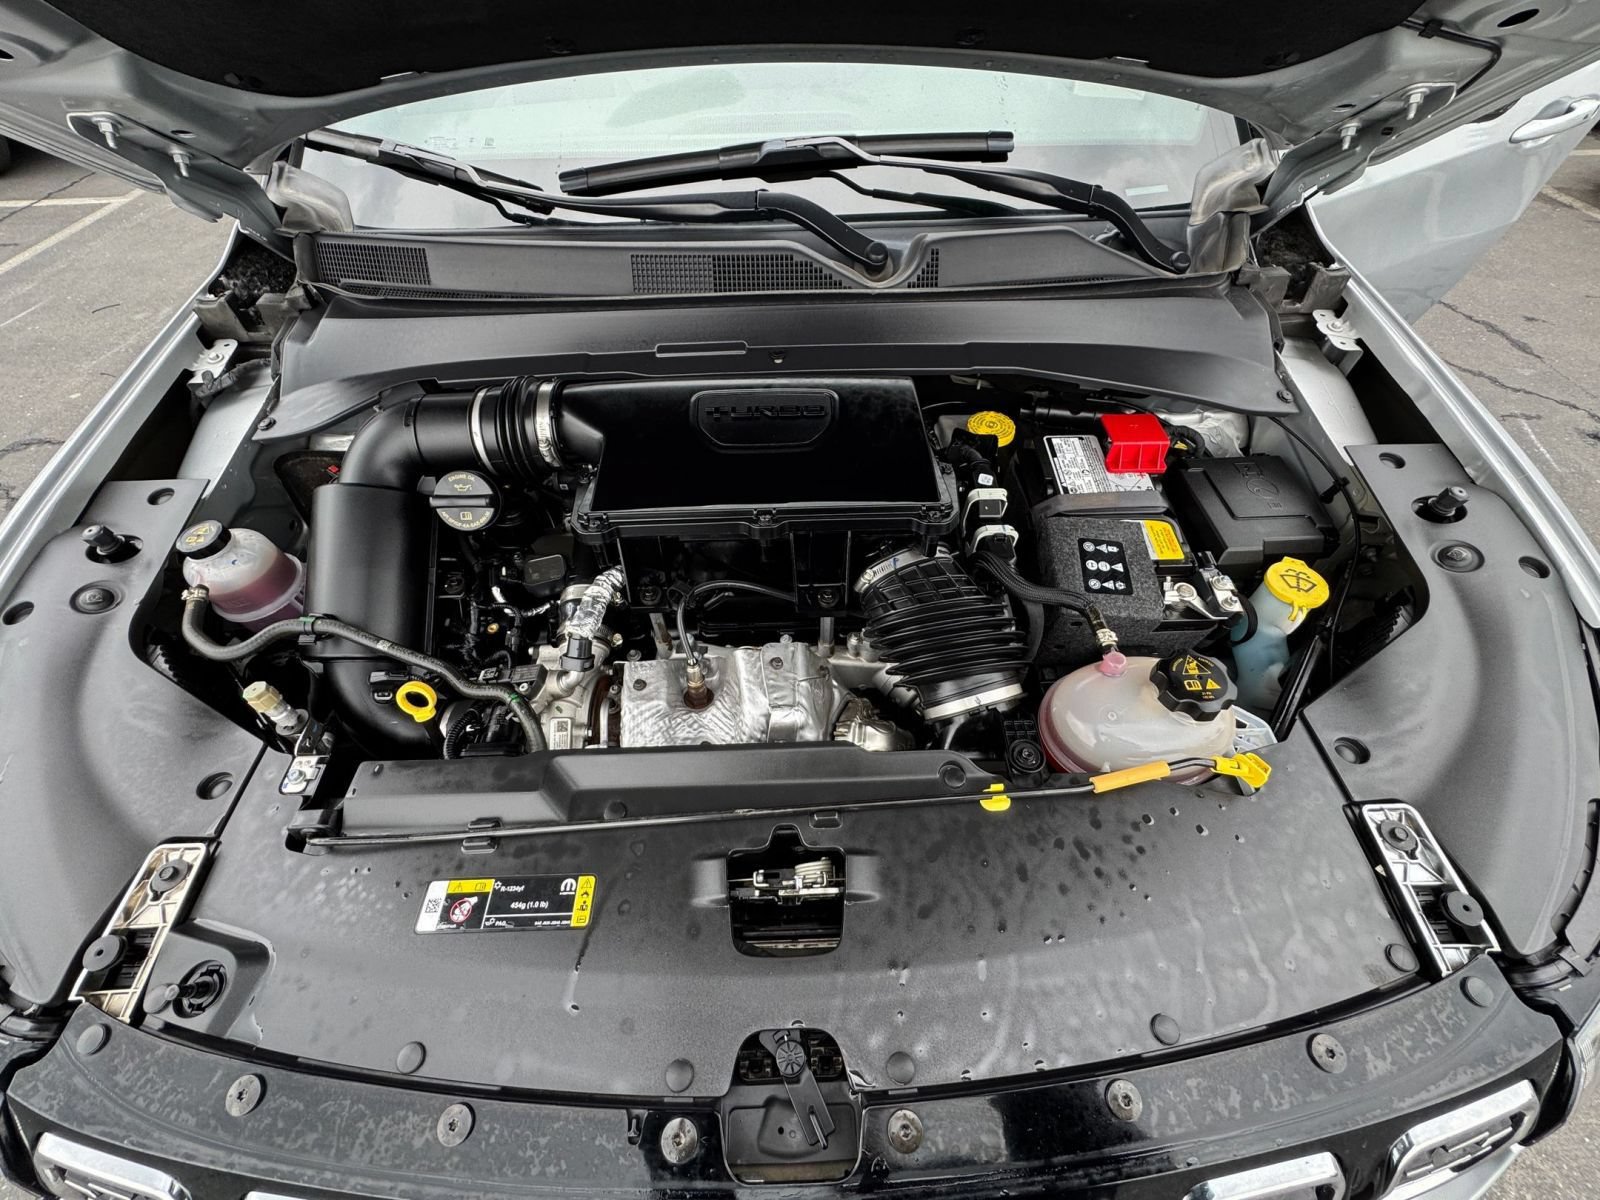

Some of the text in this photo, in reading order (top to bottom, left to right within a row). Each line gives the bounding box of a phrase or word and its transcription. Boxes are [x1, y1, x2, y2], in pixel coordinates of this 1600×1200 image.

[705, 405, 827, 420] TURBO
[510, 901, 549, 910] 454g (1.0 lb)
